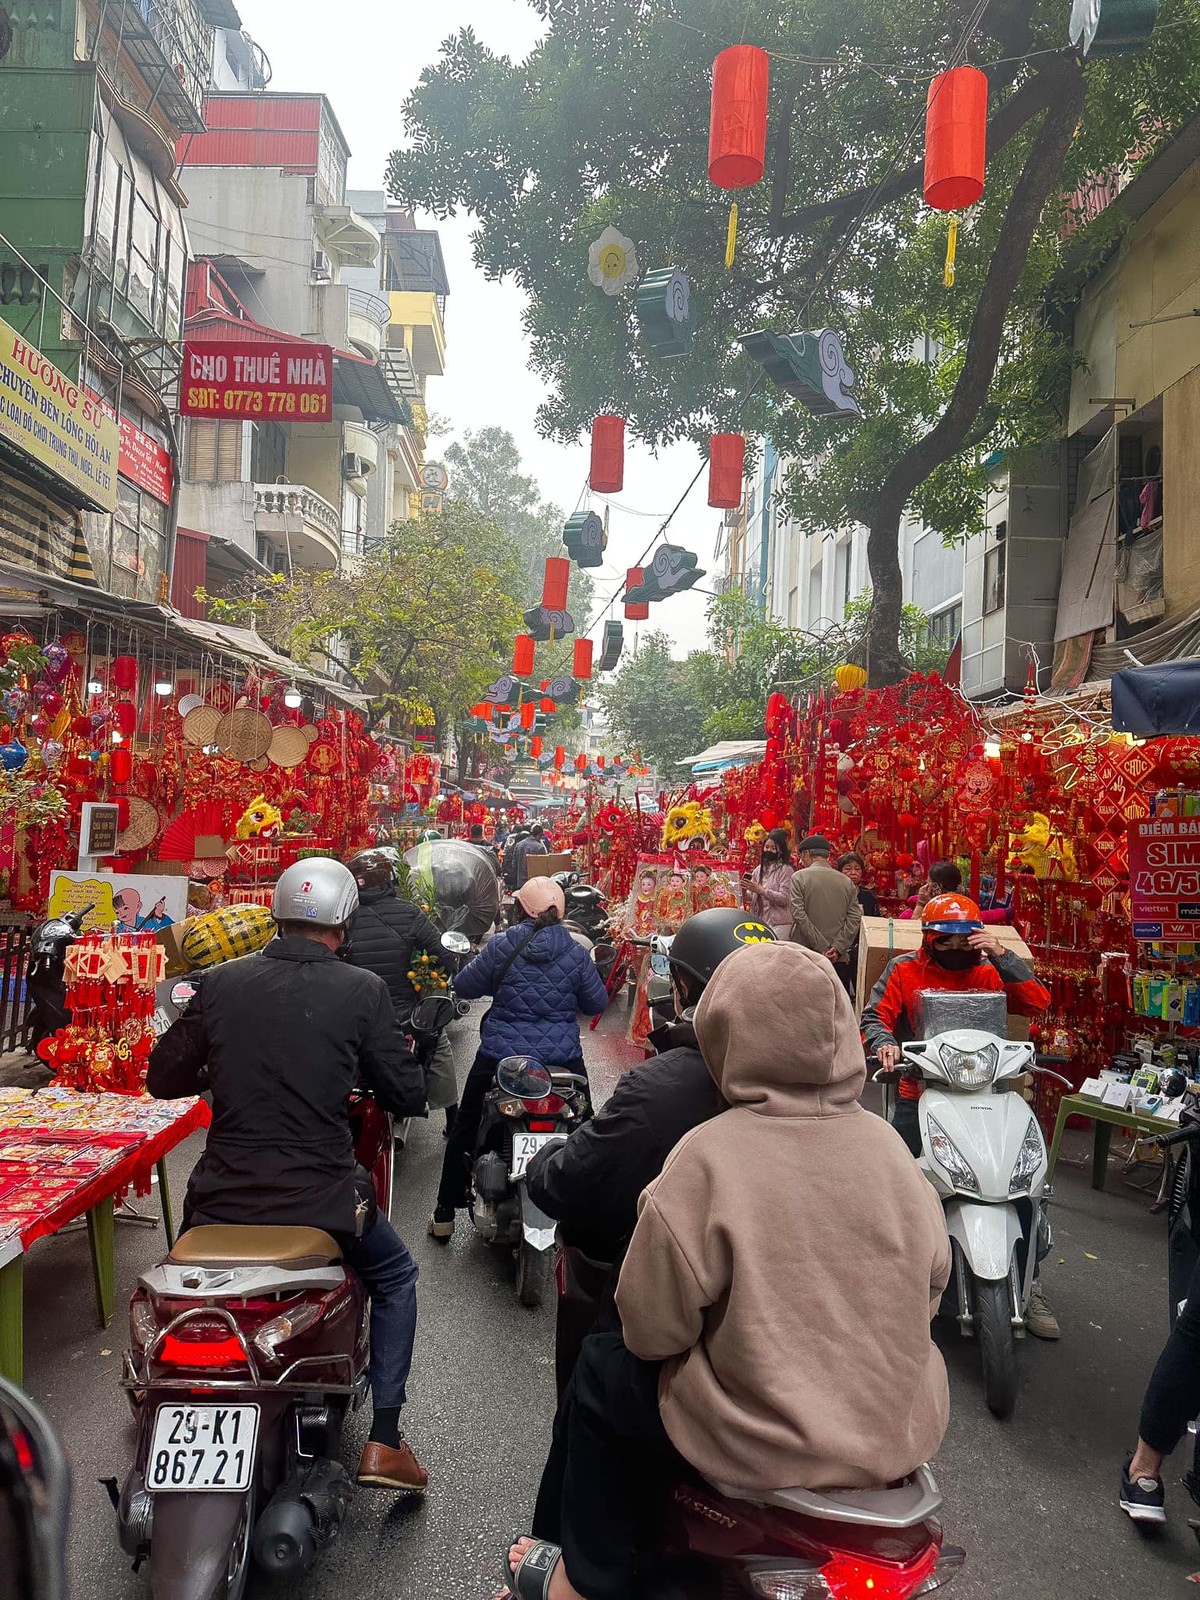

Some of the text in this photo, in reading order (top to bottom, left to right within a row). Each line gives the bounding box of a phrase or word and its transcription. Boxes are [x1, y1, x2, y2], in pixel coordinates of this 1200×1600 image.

[11, 338, 79, 409] HƯƠNG
[190, 351, 327, 385] CHO THUÊ NHÀ
[188, 387, 327, 414] SĐT: 0773 778 061
[40, 396, 59, 425] ĐÈN
[61, 410, 84, 443] LỒNG
[85, 433, 99, 457] HỘI
[99, 445, 111, 465] AN
[1102, 768, 1112, 780] AN
[1124, 755, 1148, 777] CHÚC
[1139, 819, 1200, 835] ĐIỂM BÁ
[1147, 842, 1200, 867] SIM
[1135, 870, 1200, 896] 4G/5
[167, 1410, 242, 1445] 29-K1
[153, 1449, 245, 1485] 867.21
